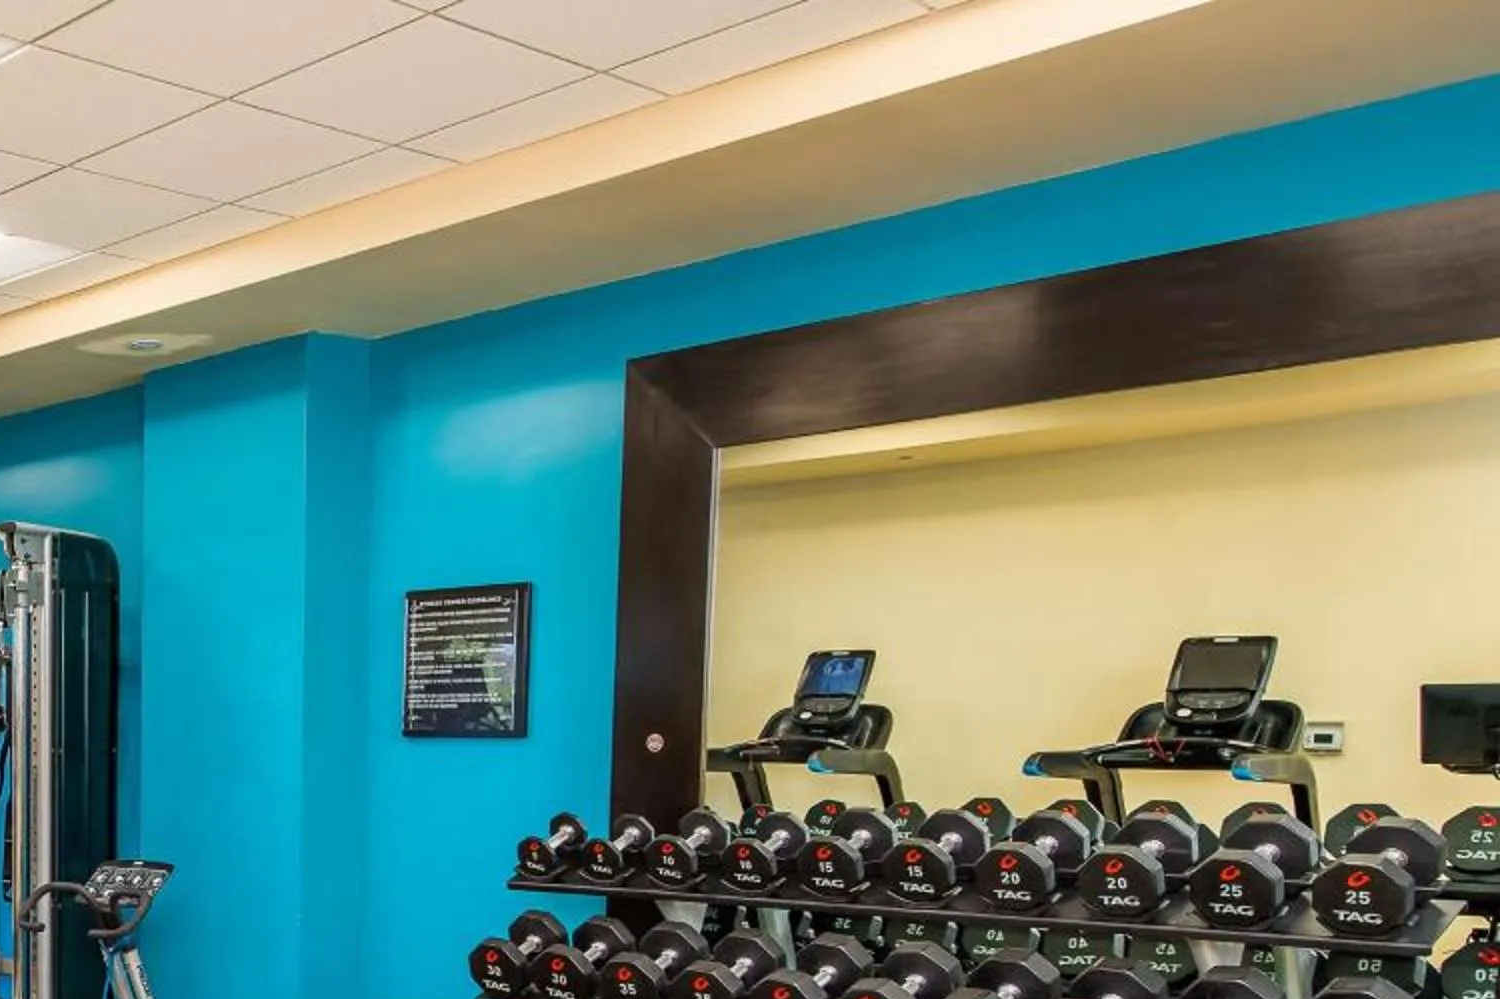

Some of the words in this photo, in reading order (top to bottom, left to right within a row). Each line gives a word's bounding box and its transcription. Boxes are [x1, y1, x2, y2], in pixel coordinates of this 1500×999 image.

[656, 867, 683, 879] TAG
[818, 861, 834, 873] 15
[907, 865, 924, 878] 15
[733, 872, 762, 884] TAG
[811, 877, 845, 889] TAG
[1000, 871, 1021, 885] 20
[1106, 877, 1128, 890] 20
[899, 881, 935, 894] TAG
[1219, 883, 1243, 898] 25
[992, 889, 1032, 901] TAG
[1098, 895, 1141, 907] TAG
[1345, 890, 1371, 905] 25
[1209, 902, 1255, 917] TAG
[1332, 909, 1383, 925] TAG
[482, 979, 511, 993] TAG
[619, 983, 637, 995] 35
